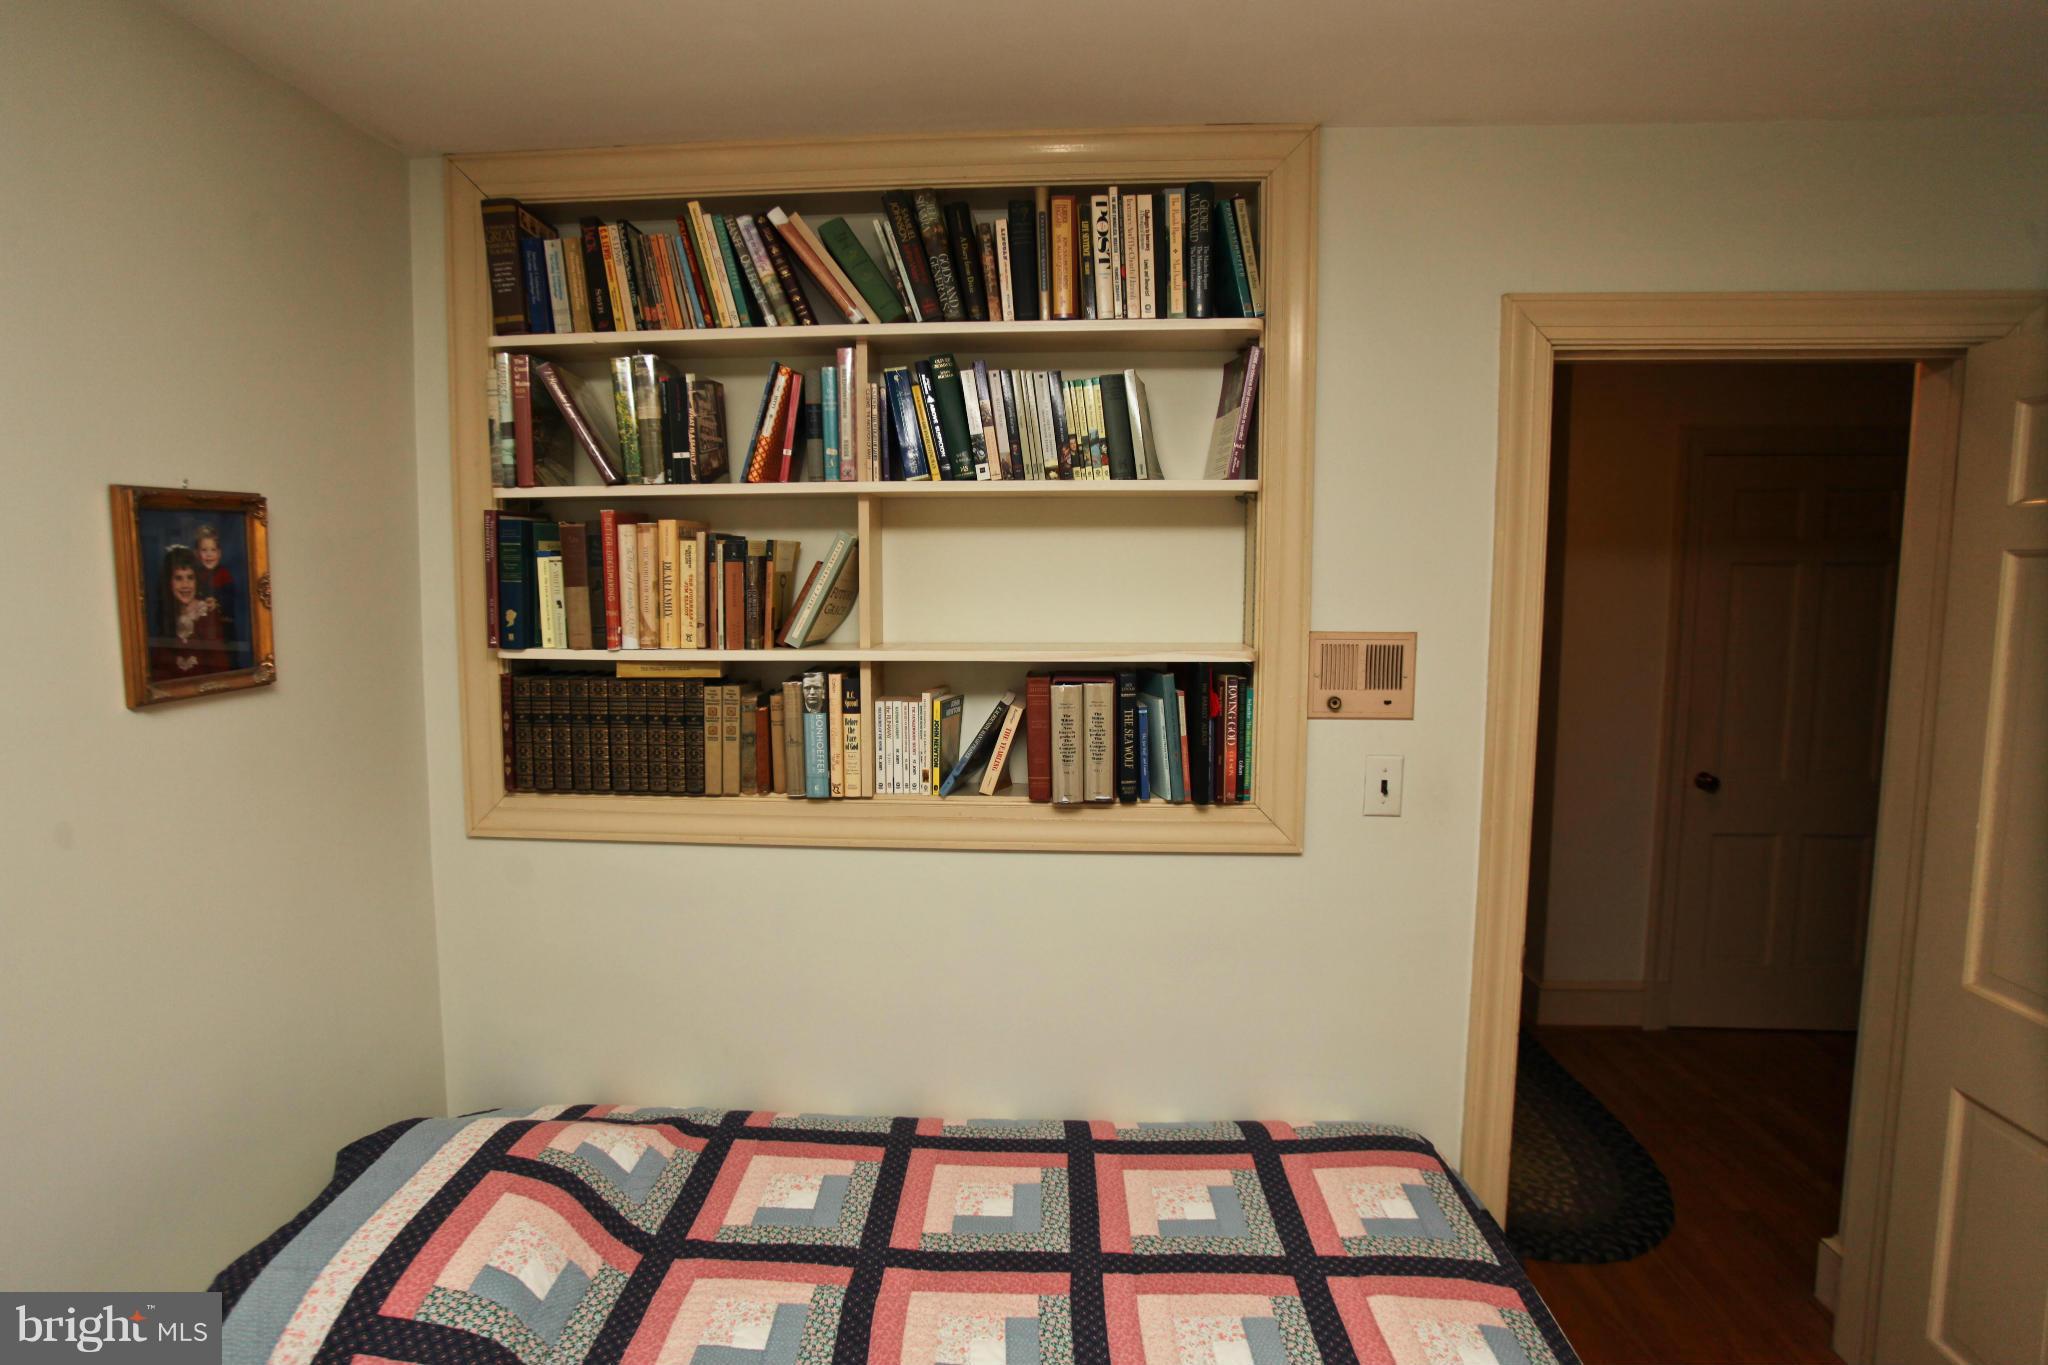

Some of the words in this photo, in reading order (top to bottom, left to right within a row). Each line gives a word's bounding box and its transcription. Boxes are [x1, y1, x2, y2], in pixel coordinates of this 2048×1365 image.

[1198, 200, 1210, 233] GEORGE
[1082, 233, 1091, 256] SENTENCE
[1095, 201, 1111, 270] POST
[930, 256, 949, 312] GENERALS
[937, 254, 953, 283] GODS
[945, 284, 960, 312] AND
[1248, 364, 1258, 387] evidence
[688, 408, 697, 426] WHAT
[929, 404, 939, 425] ABOVE
[934, 426, 946, 457] SUSPICION
[604, 517, 613, 542] BETTER
[606, 546, 616, 602] DRESSMAKING
[663, 561, 673, 586] DEAR
[663, 588, 673, 618] FAMILY
[1227, 684, 1239, 721] LOVING
[844, 718, 859, 727] Before
[1124, 709, 1134, 726] THE
[815, 714, 826, 777] BONHOEFFER
[846, 735, 857, 743] Face
[1001, 727, 1012, 742] THE
[1124, 728, 1134, 745] SEA
[1227, 721, 1238, 746] GOD
[851, 742, 859, 751] God
[933, 738, 941, 769] NEWTON
[991, 742, 1007, 773] YEARLING
[1124, 745, 1134, 769] WOLF
